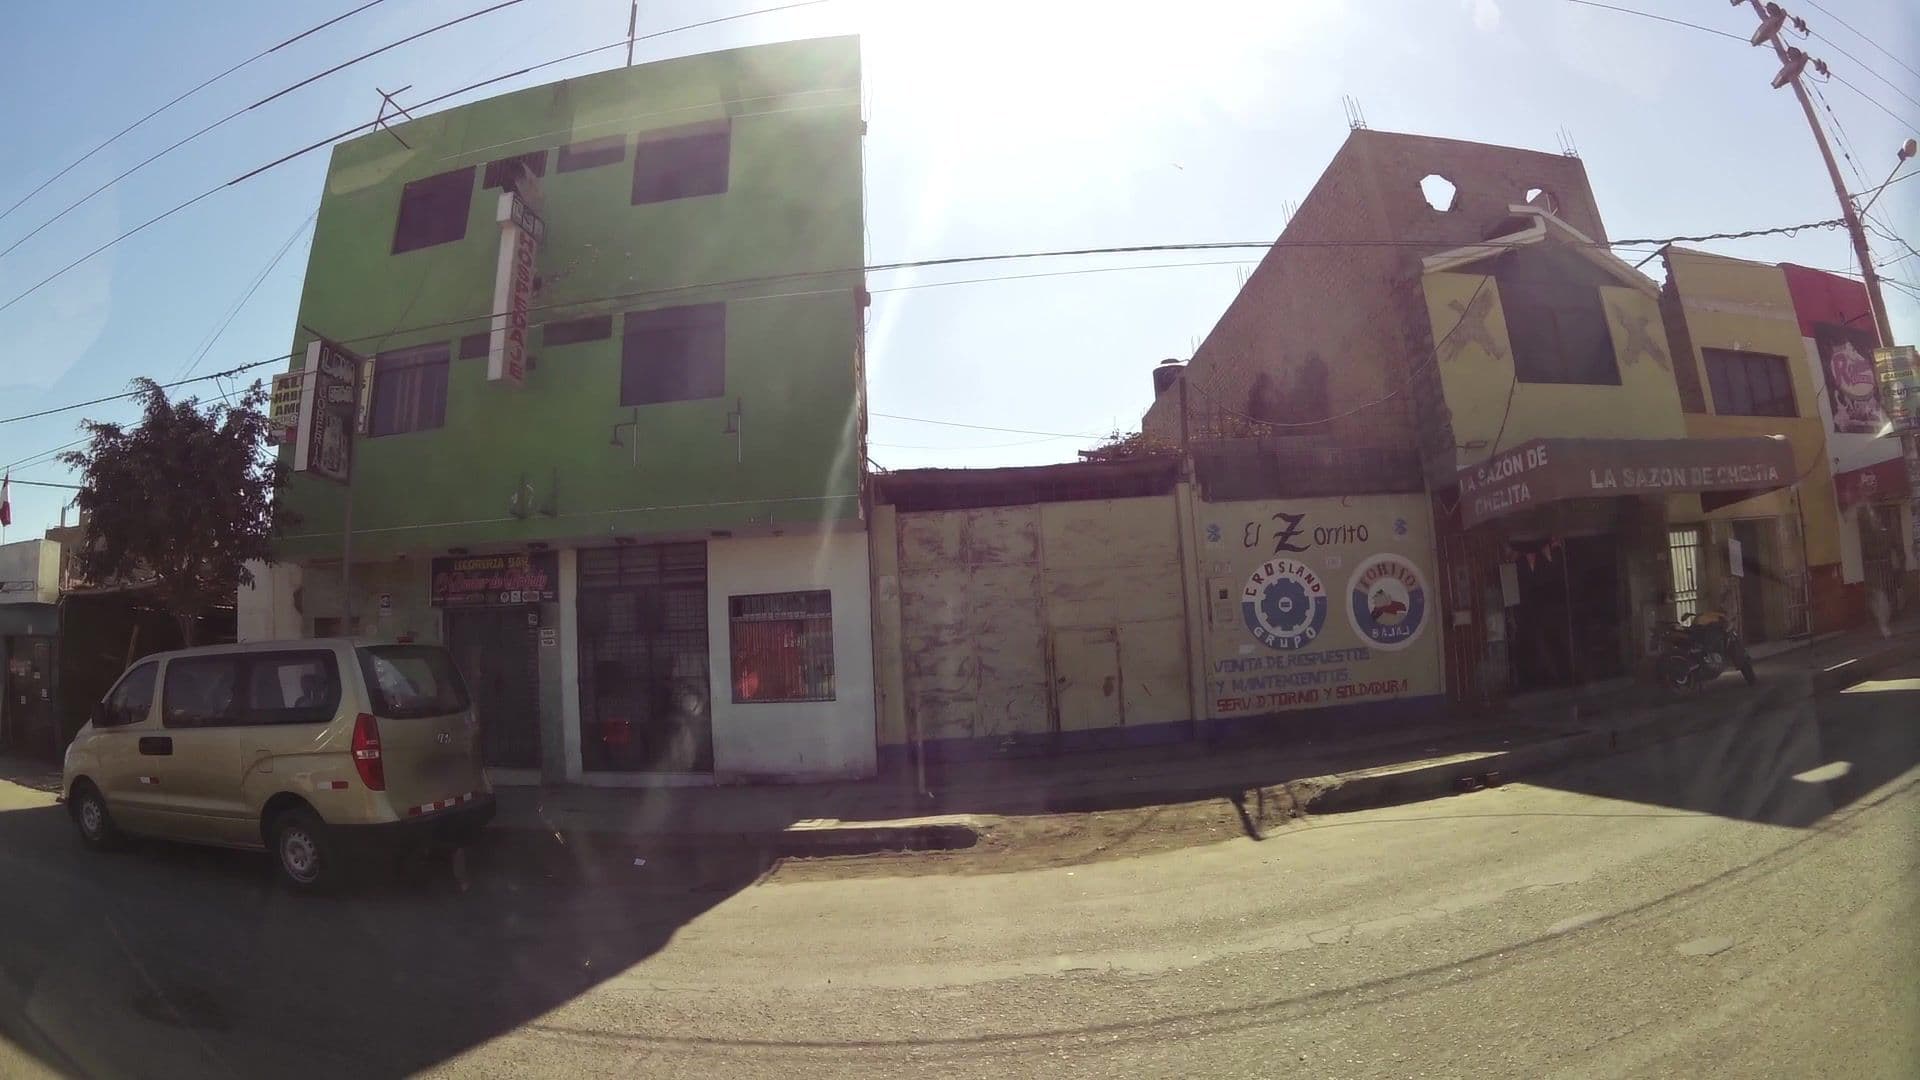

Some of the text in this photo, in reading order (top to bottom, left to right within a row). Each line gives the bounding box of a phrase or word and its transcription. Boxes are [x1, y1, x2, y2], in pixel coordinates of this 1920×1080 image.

[508, 231, 535, 380] HOSPEDAJE
[1527, 445, 1548, 469] DE
[1590, 469, 1617, 489] LA
[1693, 466, 1713, 486] DE
[1717, 464, 1779, 485] CHELITA
[1475, 482, 1531, 516] CHELITA
[1243, 521, 1262, 548] El
[1359, 562, 1416, 588] TORITO
[1253, 626, 1316, 649] GRUPO
[1214, 656, 1263, 673] VENTA
[1266, 655, 1288, 669] DE
[1215, 680, 1225, 696] Y
[1268, 689, 1319, 707] TORNO
[1323, 687, 1333, 701] Y
[1336, 679, 1409, 699] SOLDADURA
